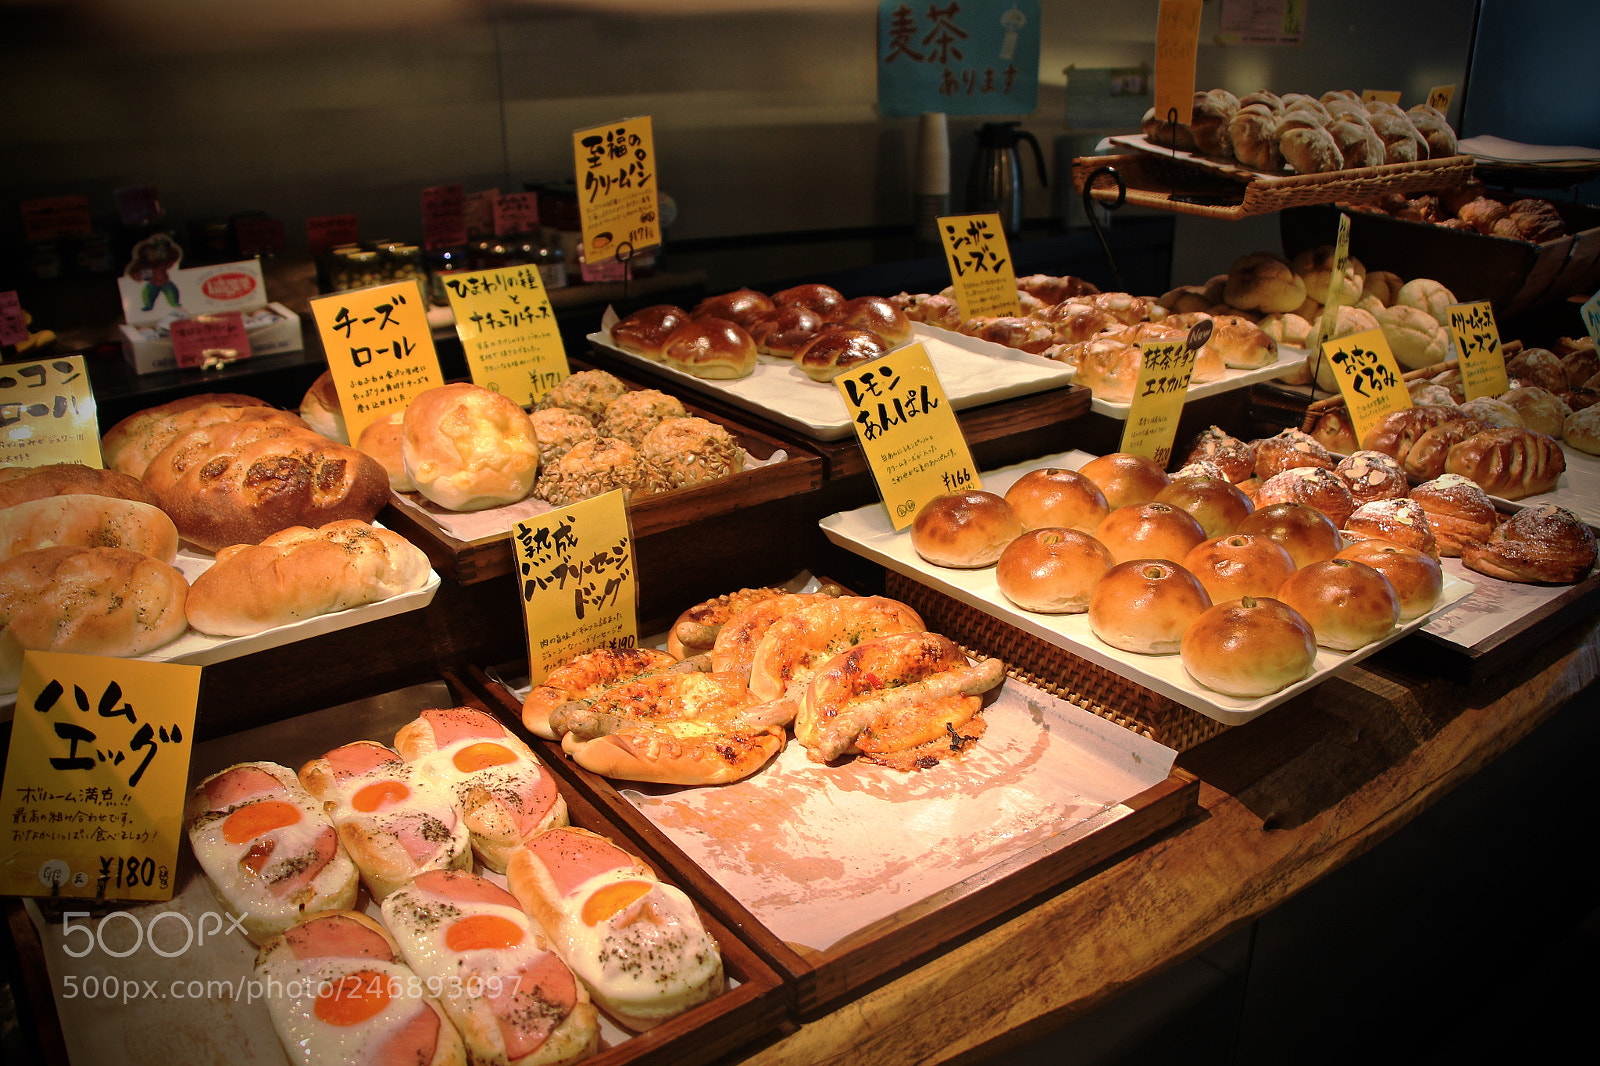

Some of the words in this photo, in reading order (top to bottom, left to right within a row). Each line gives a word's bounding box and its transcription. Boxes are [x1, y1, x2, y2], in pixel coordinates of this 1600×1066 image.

[883, 2, 969, 65] 麦茶
[938, 63, 1018, 96] あります
[581, 128, 641, 169] 至福の
[585, 149, 652, 203] クリームパン
[946, 220, 995, 250] シュガー
[952, 244, 1006, 277] レーズン
[446, 268, 539, 299] ひまわりの種
[508, 294, 521, 305] と
[332, 294, 407, 339] チーズ
[469, 300, 551, 333] ナチュラルチーズ
[1190, 327, 1212, 343] New
[1459, 332, 1498, 359] レーズン
[350, 336, 417, 368] ロール
[1331, 344, 1378, 375] おさつ
[528, 369, 561, 394] ¥171
[843, 366, 901, 407] レモン
[1353, 364, 1399, 398] くるみ
[856, 385, 938, 441] あんぱん
[942, 467, 971, 493] ¥166
[517, 515, 578, 576] 熟成
[525, 537, 629, 602] ハーブソーセージ
[575, 568, 630, 620] ドッグ
[609, 634, 635, 650] ¥190
[34, 679, 137, 724] ハム
[49, 722, 183, 788] エッグ
[99, 856, 156, 889] ¥180
